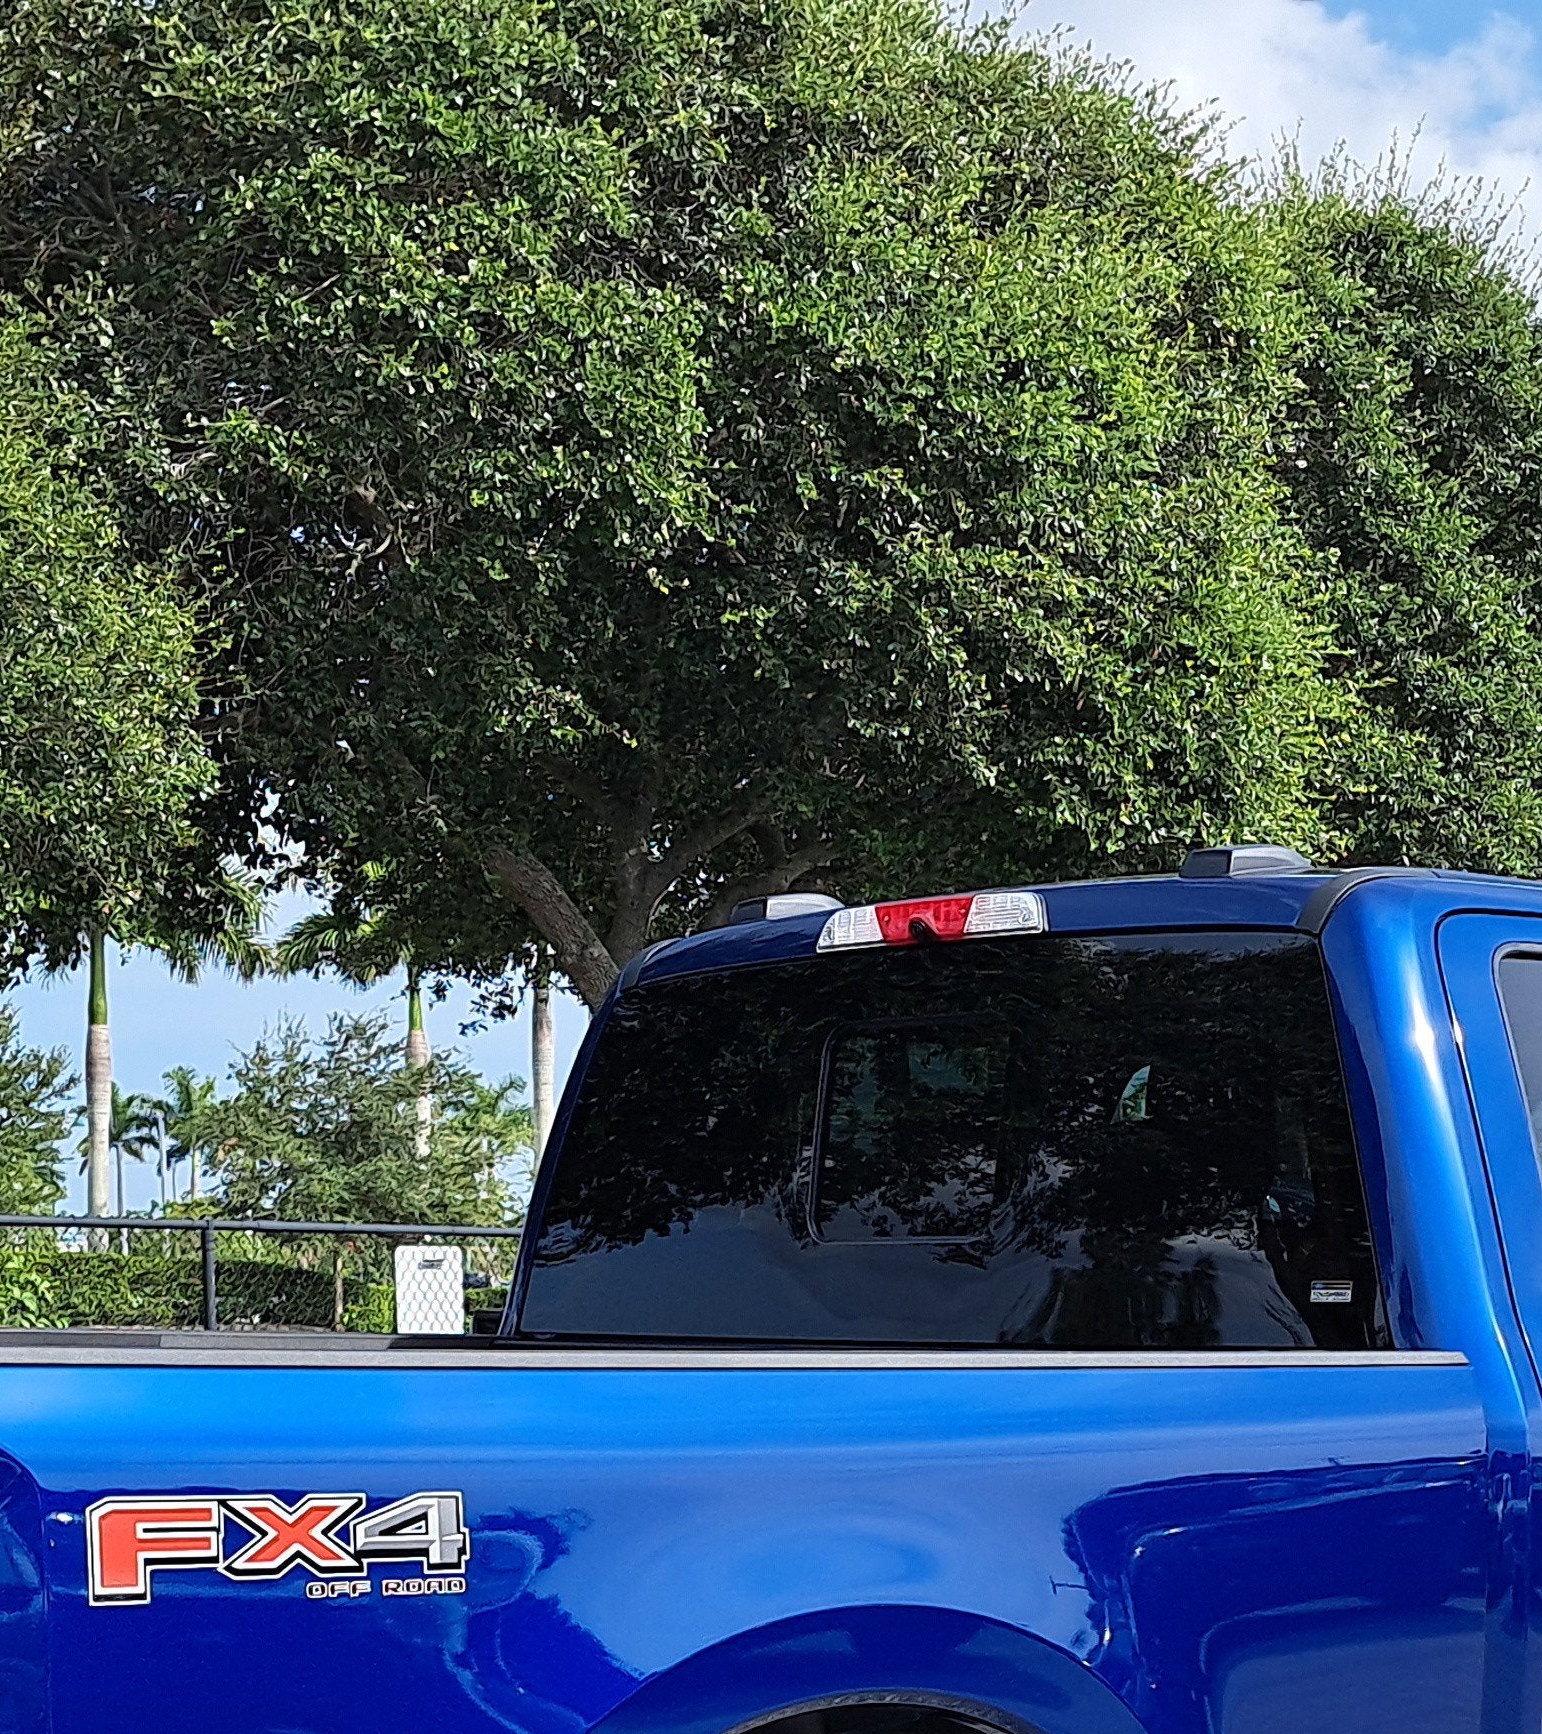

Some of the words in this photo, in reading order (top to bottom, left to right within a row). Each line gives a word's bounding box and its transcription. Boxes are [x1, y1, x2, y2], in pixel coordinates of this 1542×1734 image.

[86, 1491, 469, 1606] FX4
[306, 1579, 371, 1599] OFF
[382, 1576, 466, 1597] ROAD
